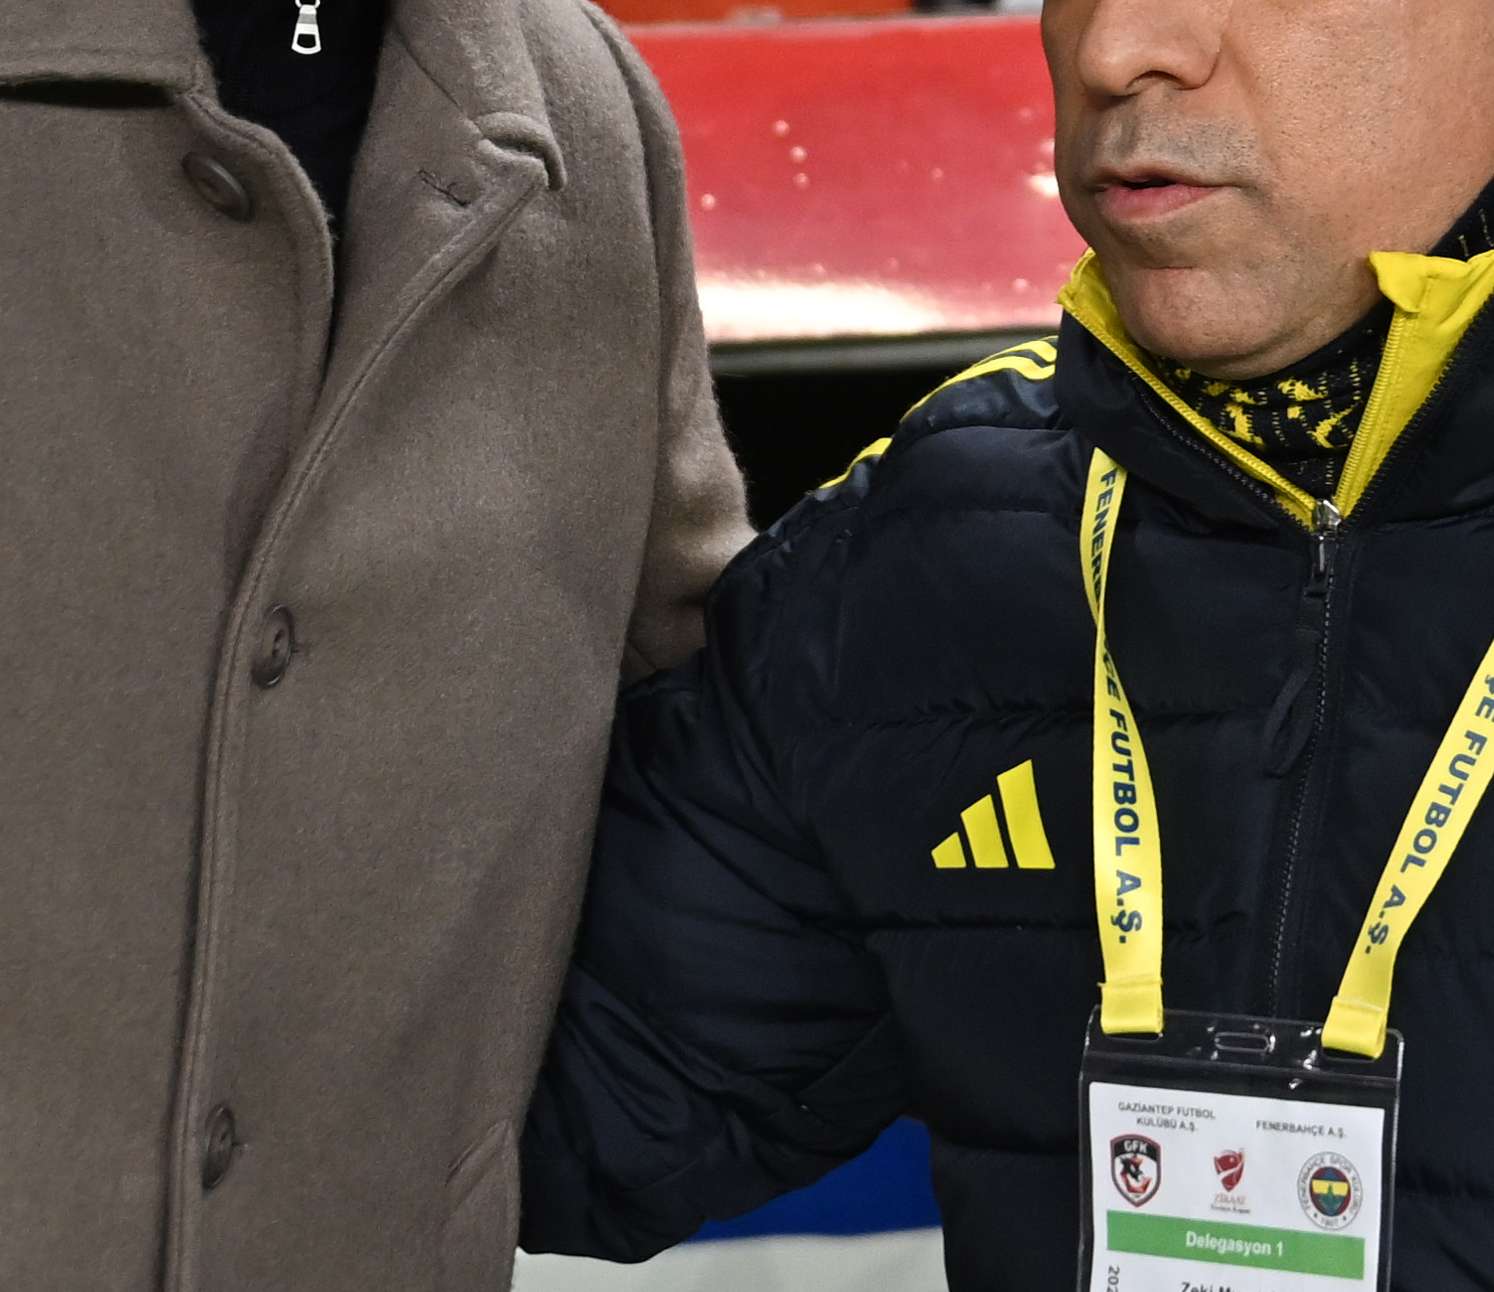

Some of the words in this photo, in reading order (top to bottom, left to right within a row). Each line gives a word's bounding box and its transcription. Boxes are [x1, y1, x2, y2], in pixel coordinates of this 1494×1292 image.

[1109, 708, 1140, 856] FUTBOL
[1400, 729, 1488, 873] FUTBOL
[1111, 870, 1143, 944] A.Ş.
[1365, 884, 1407, 954] A.Ş.
[1136, 1116, 1177, 1129] KULÜBÜ
[1177, 1106, 1216, 1120] FUTBOL
[1256, 1119, 1325, 1136] FENERBAHÇE
[1123, 1139, 1149, 1154] GFK
[1186, 1231, 1272, 1257] Delegasyon
[1276, 1241, 1284, 1256] 1
